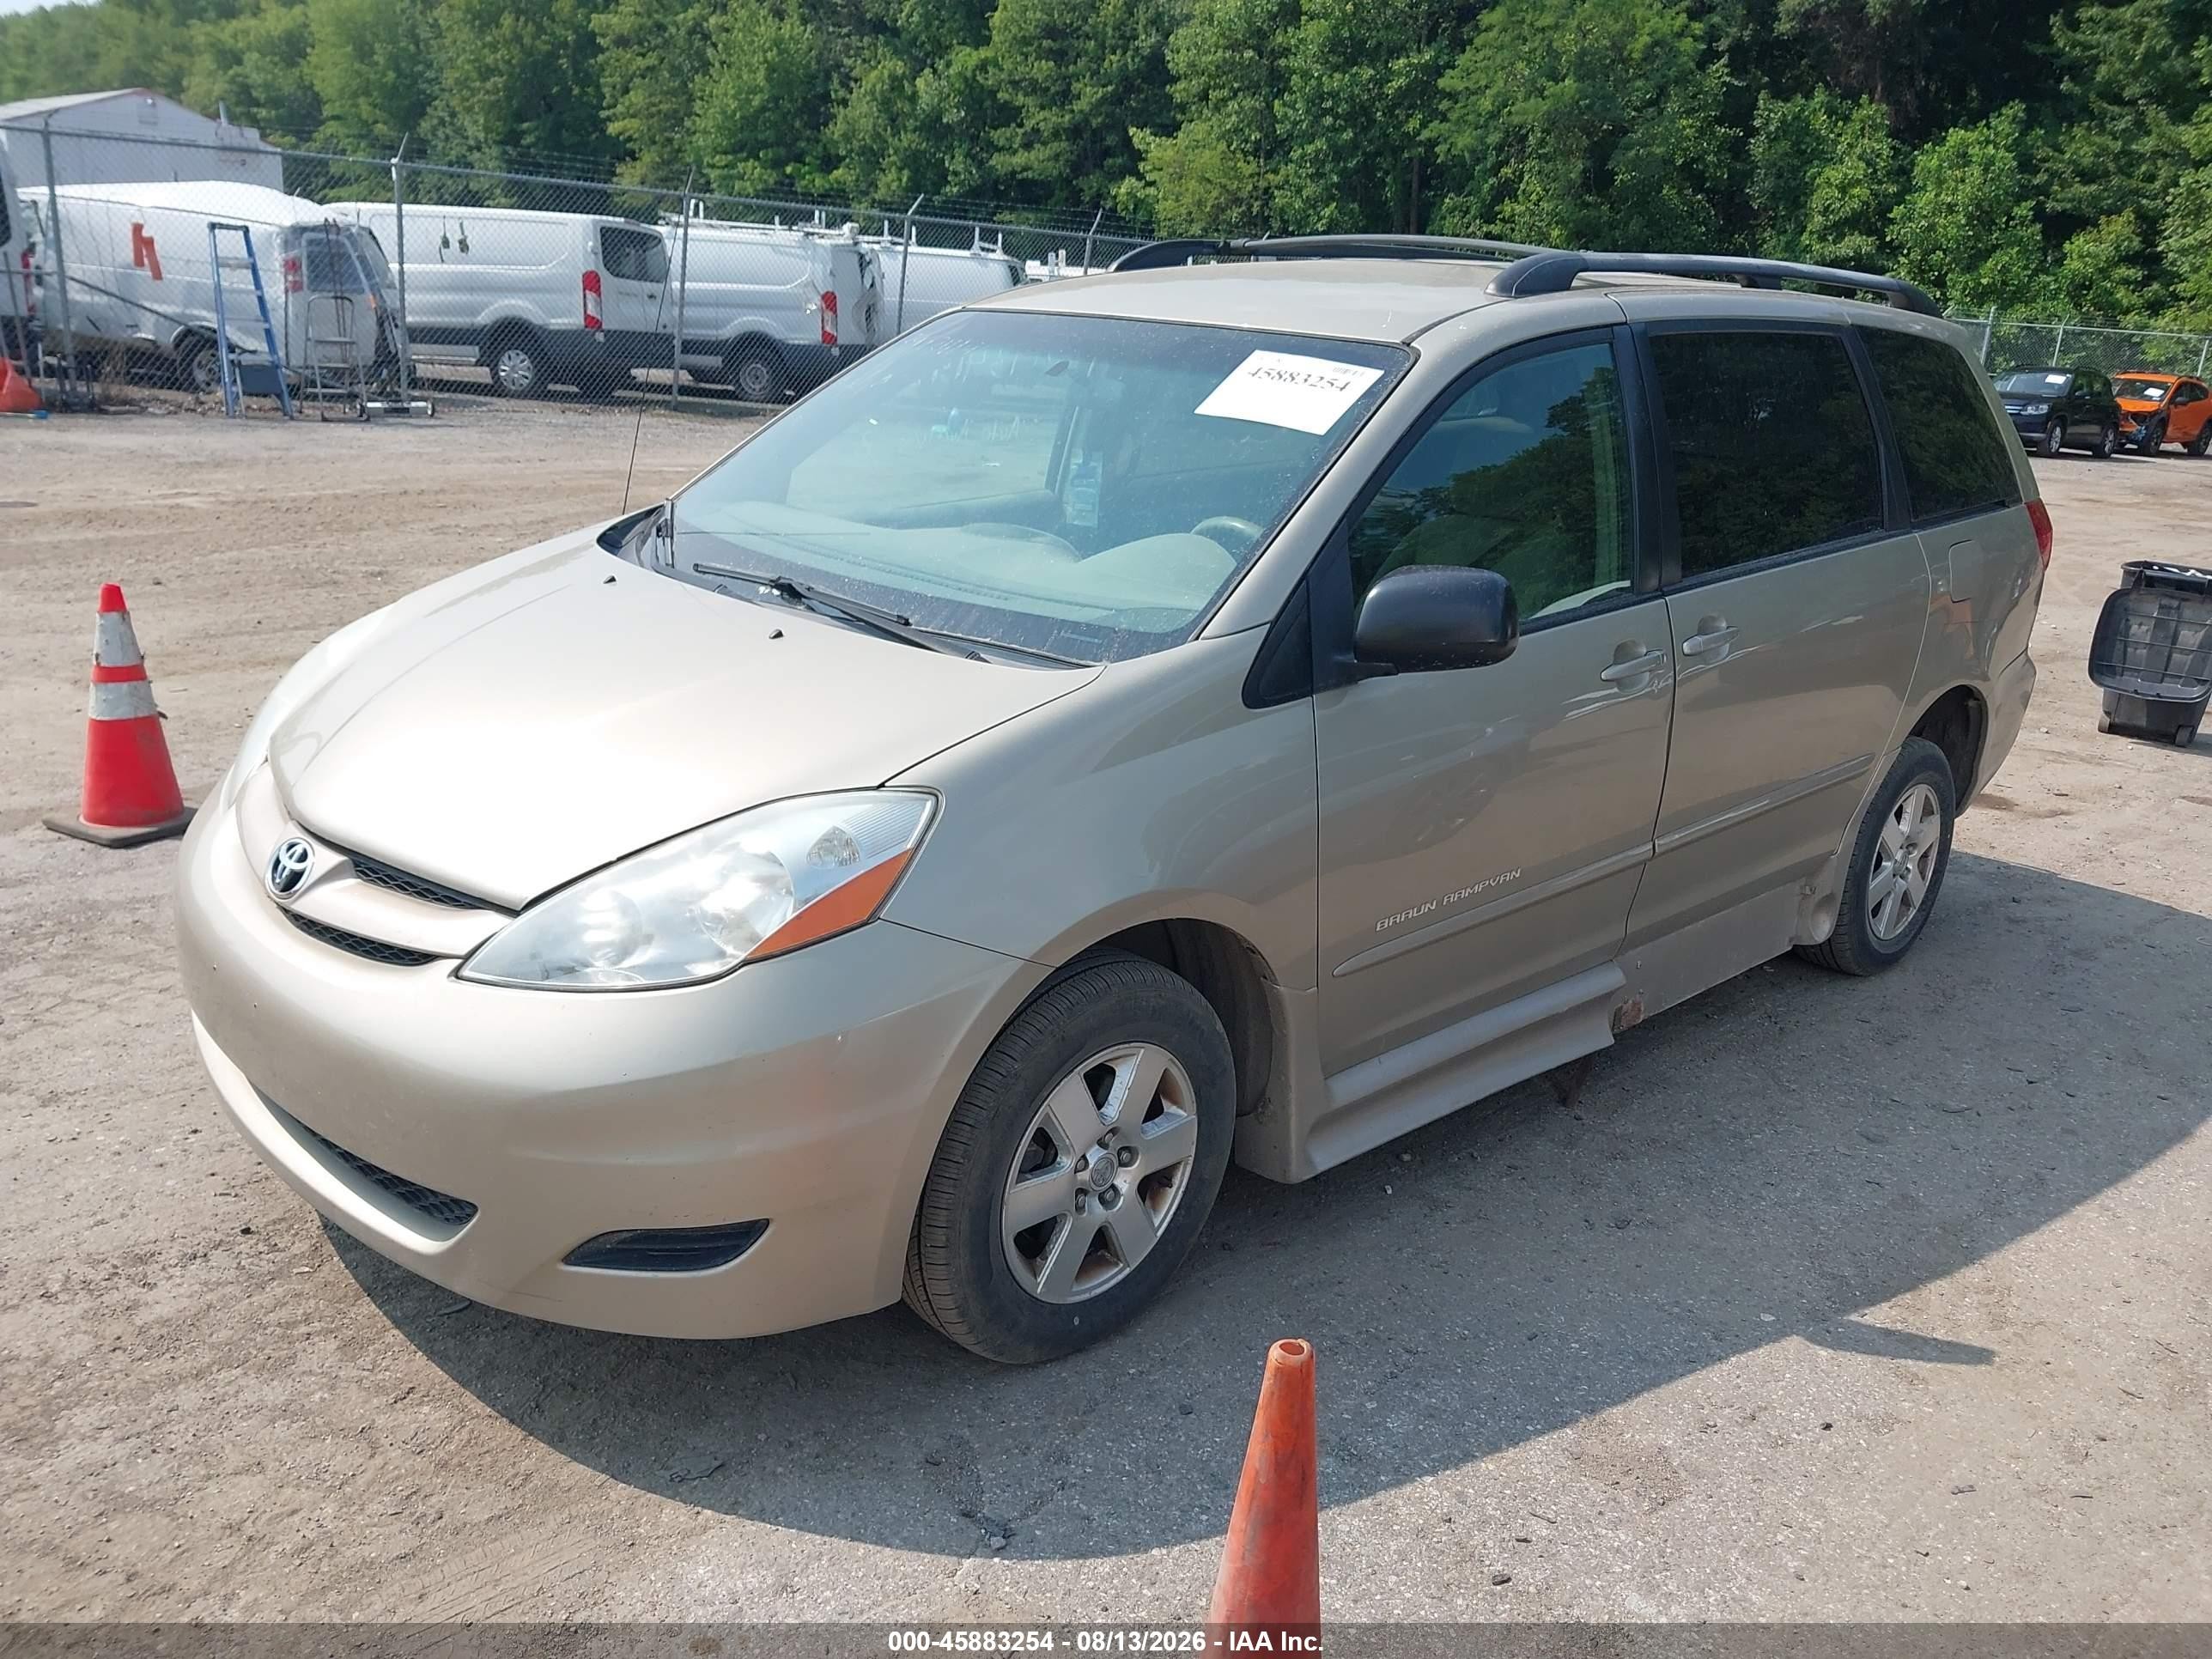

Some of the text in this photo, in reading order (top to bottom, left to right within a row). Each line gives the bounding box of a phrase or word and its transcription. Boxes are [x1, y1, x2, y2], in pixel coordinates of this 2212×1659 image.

[1248, 367, 1352, 392] 45883254
[1375, 867, 1522, 932] BRAUN RAMPVAN
